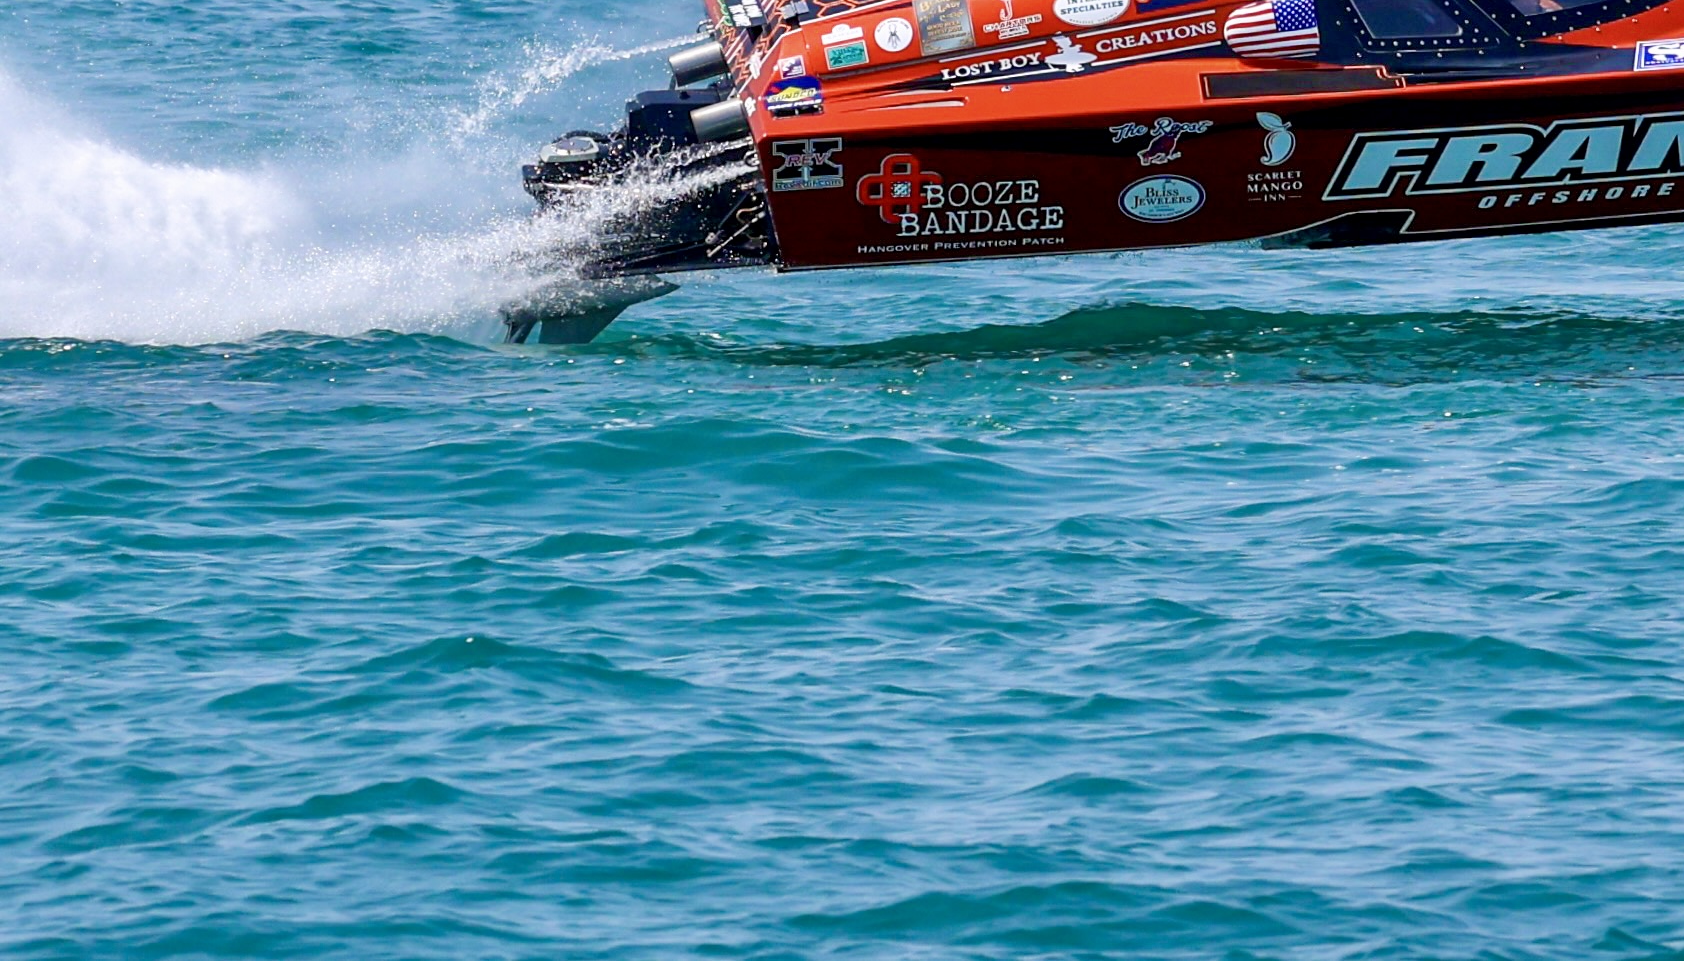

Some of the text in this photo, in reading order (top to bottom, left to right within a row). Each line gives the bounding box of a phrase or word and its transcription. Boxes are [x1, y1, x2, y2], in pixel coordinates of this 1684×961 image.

[1060, 0, 1124, 15] SPECIALTIES
[941, 21, 1217, 80] LOST BOY CREATIONS
[1109, 123, 1148, 143] The
[785, 153, 828, 167] REV
[1247, 171, 1301, 181] SCARLET
[922, 180, 1039, 208] BOOZE
[1146, 187, 1179, 197] BLISS
[1247, 181, 1303, 193] MANGO
[1131, 196, 1192, 209] JEWELERS
[1264, 193, 1286, 202] INN
[1478, 183, 1674, 209] OFFSHORE
[894, 206, 1064, 236] BANDAGE
[857, 237, 1065, 253] HANGOVER PREVENTION PATCH
